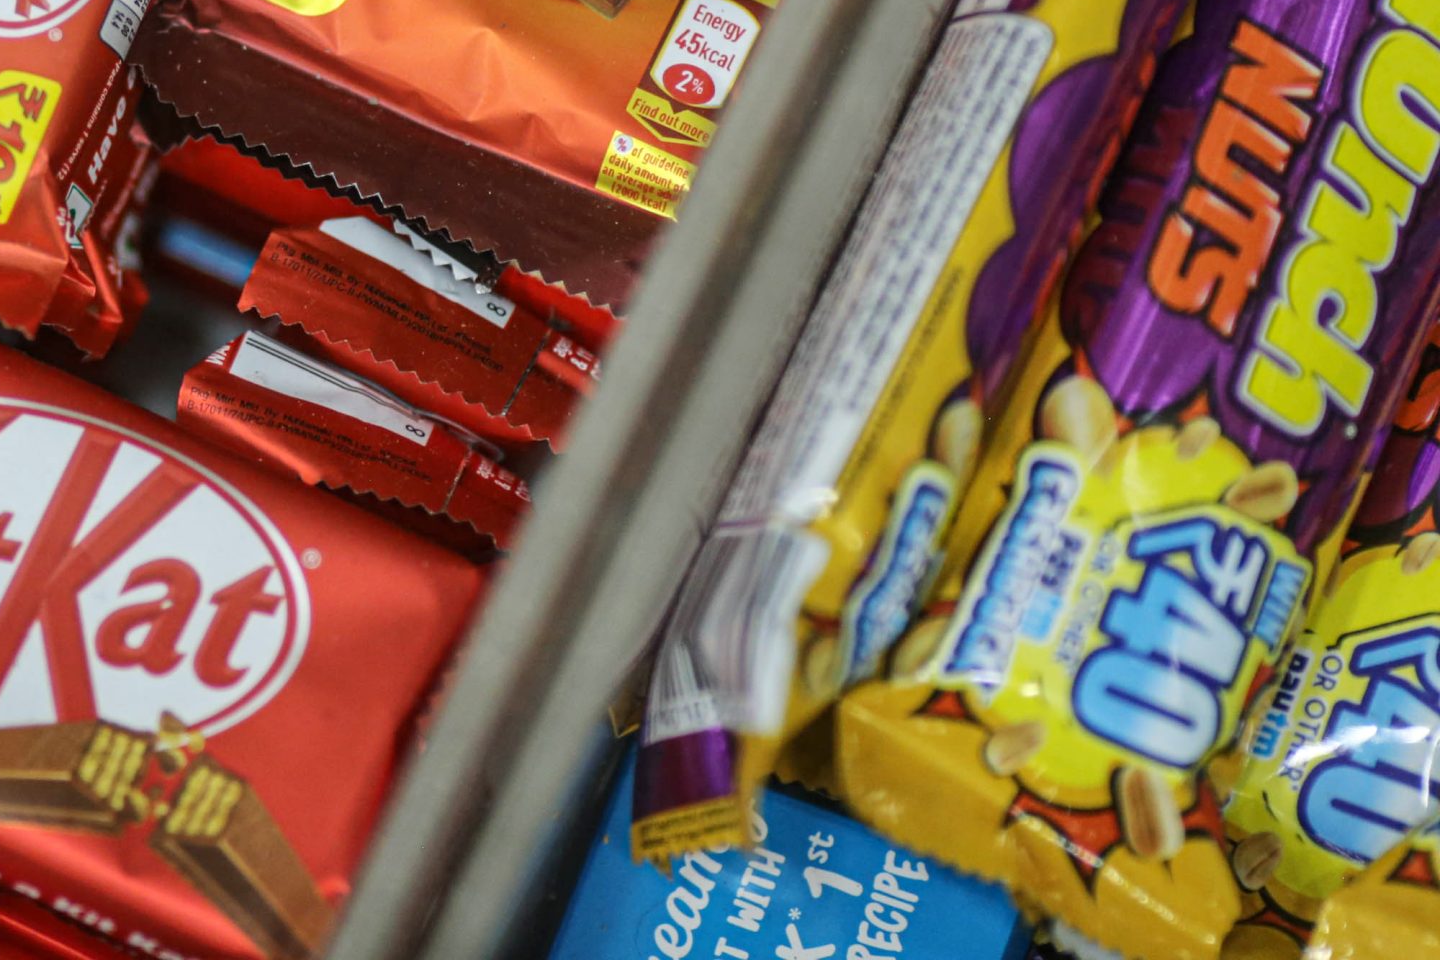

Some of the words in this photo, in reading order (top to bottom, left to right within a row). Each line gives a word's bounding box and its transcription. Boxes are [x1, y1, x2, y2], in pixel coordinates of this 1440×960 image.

[689, 2, 749, 44] Energy
[671, 25, 739, 72] 45kcal
[673, 67, 708, 99] 2%
[79, 94, 139, 187] Have
[631, 98, 659, 119] Find
[657, 112, 679, 129] out
[677, 121, 711, 144] more
[600, 164, 617, 179] an
[606, 153, 634, 175] daily
[633, 165, 672, 190] amount
[640, 150, 691, 182] guideline
[1151, 17, 1322, 337] NUTS
[1311, 650, 1346, 693] OR
[715, 841, 797, 937] WITH
